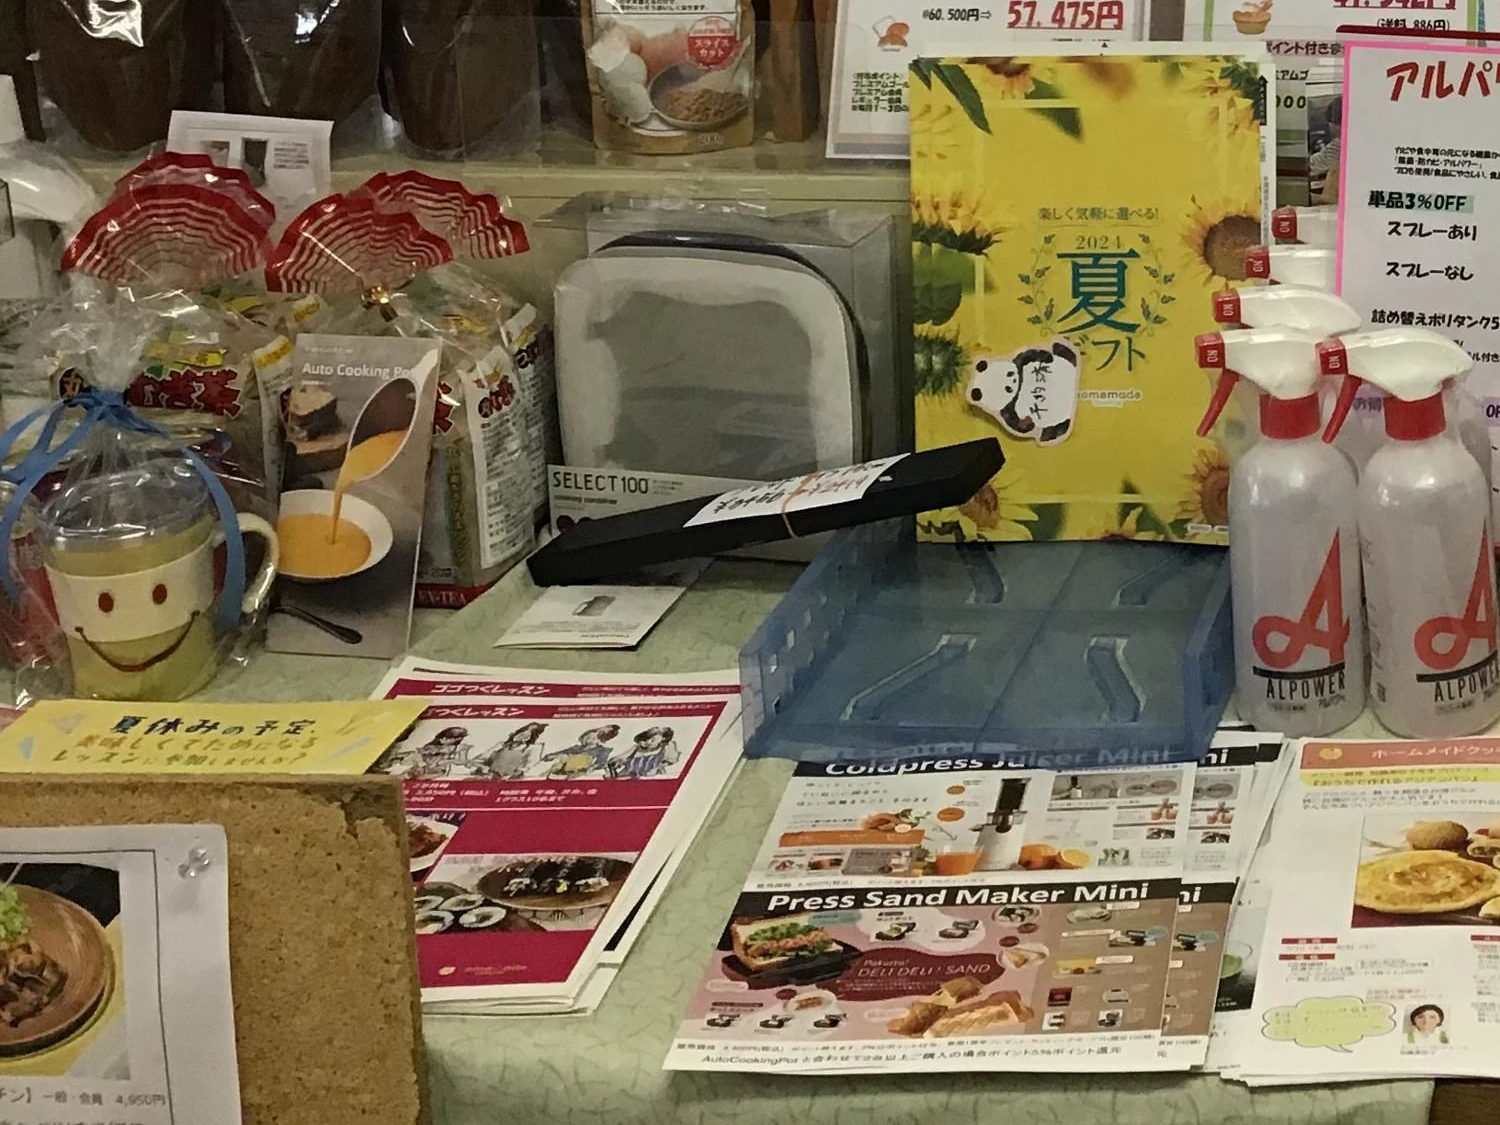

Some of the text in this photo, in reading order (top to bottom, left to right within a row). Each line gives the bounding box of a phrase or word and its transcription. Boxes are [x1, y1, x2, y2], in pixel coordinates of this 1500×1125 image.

[1368, 190, 1467, 212] 単品3%OFF
[1075, 235, 1122, 250] 2024
[1387, 221, 1478, 242] スプレーあり
[1386, 261, 1474, 283] スプレーなし
[1056, 248, 1142, 335] 夏
[302, 362, 334, 374] Auto
[336, 363, 391, 379] Cooking
[1266, 672, 1346, 701] ALPOWER
[767, 882, 1149, 912] Press Sand Maker Mini
[944, 963, 991, 975] SAND
